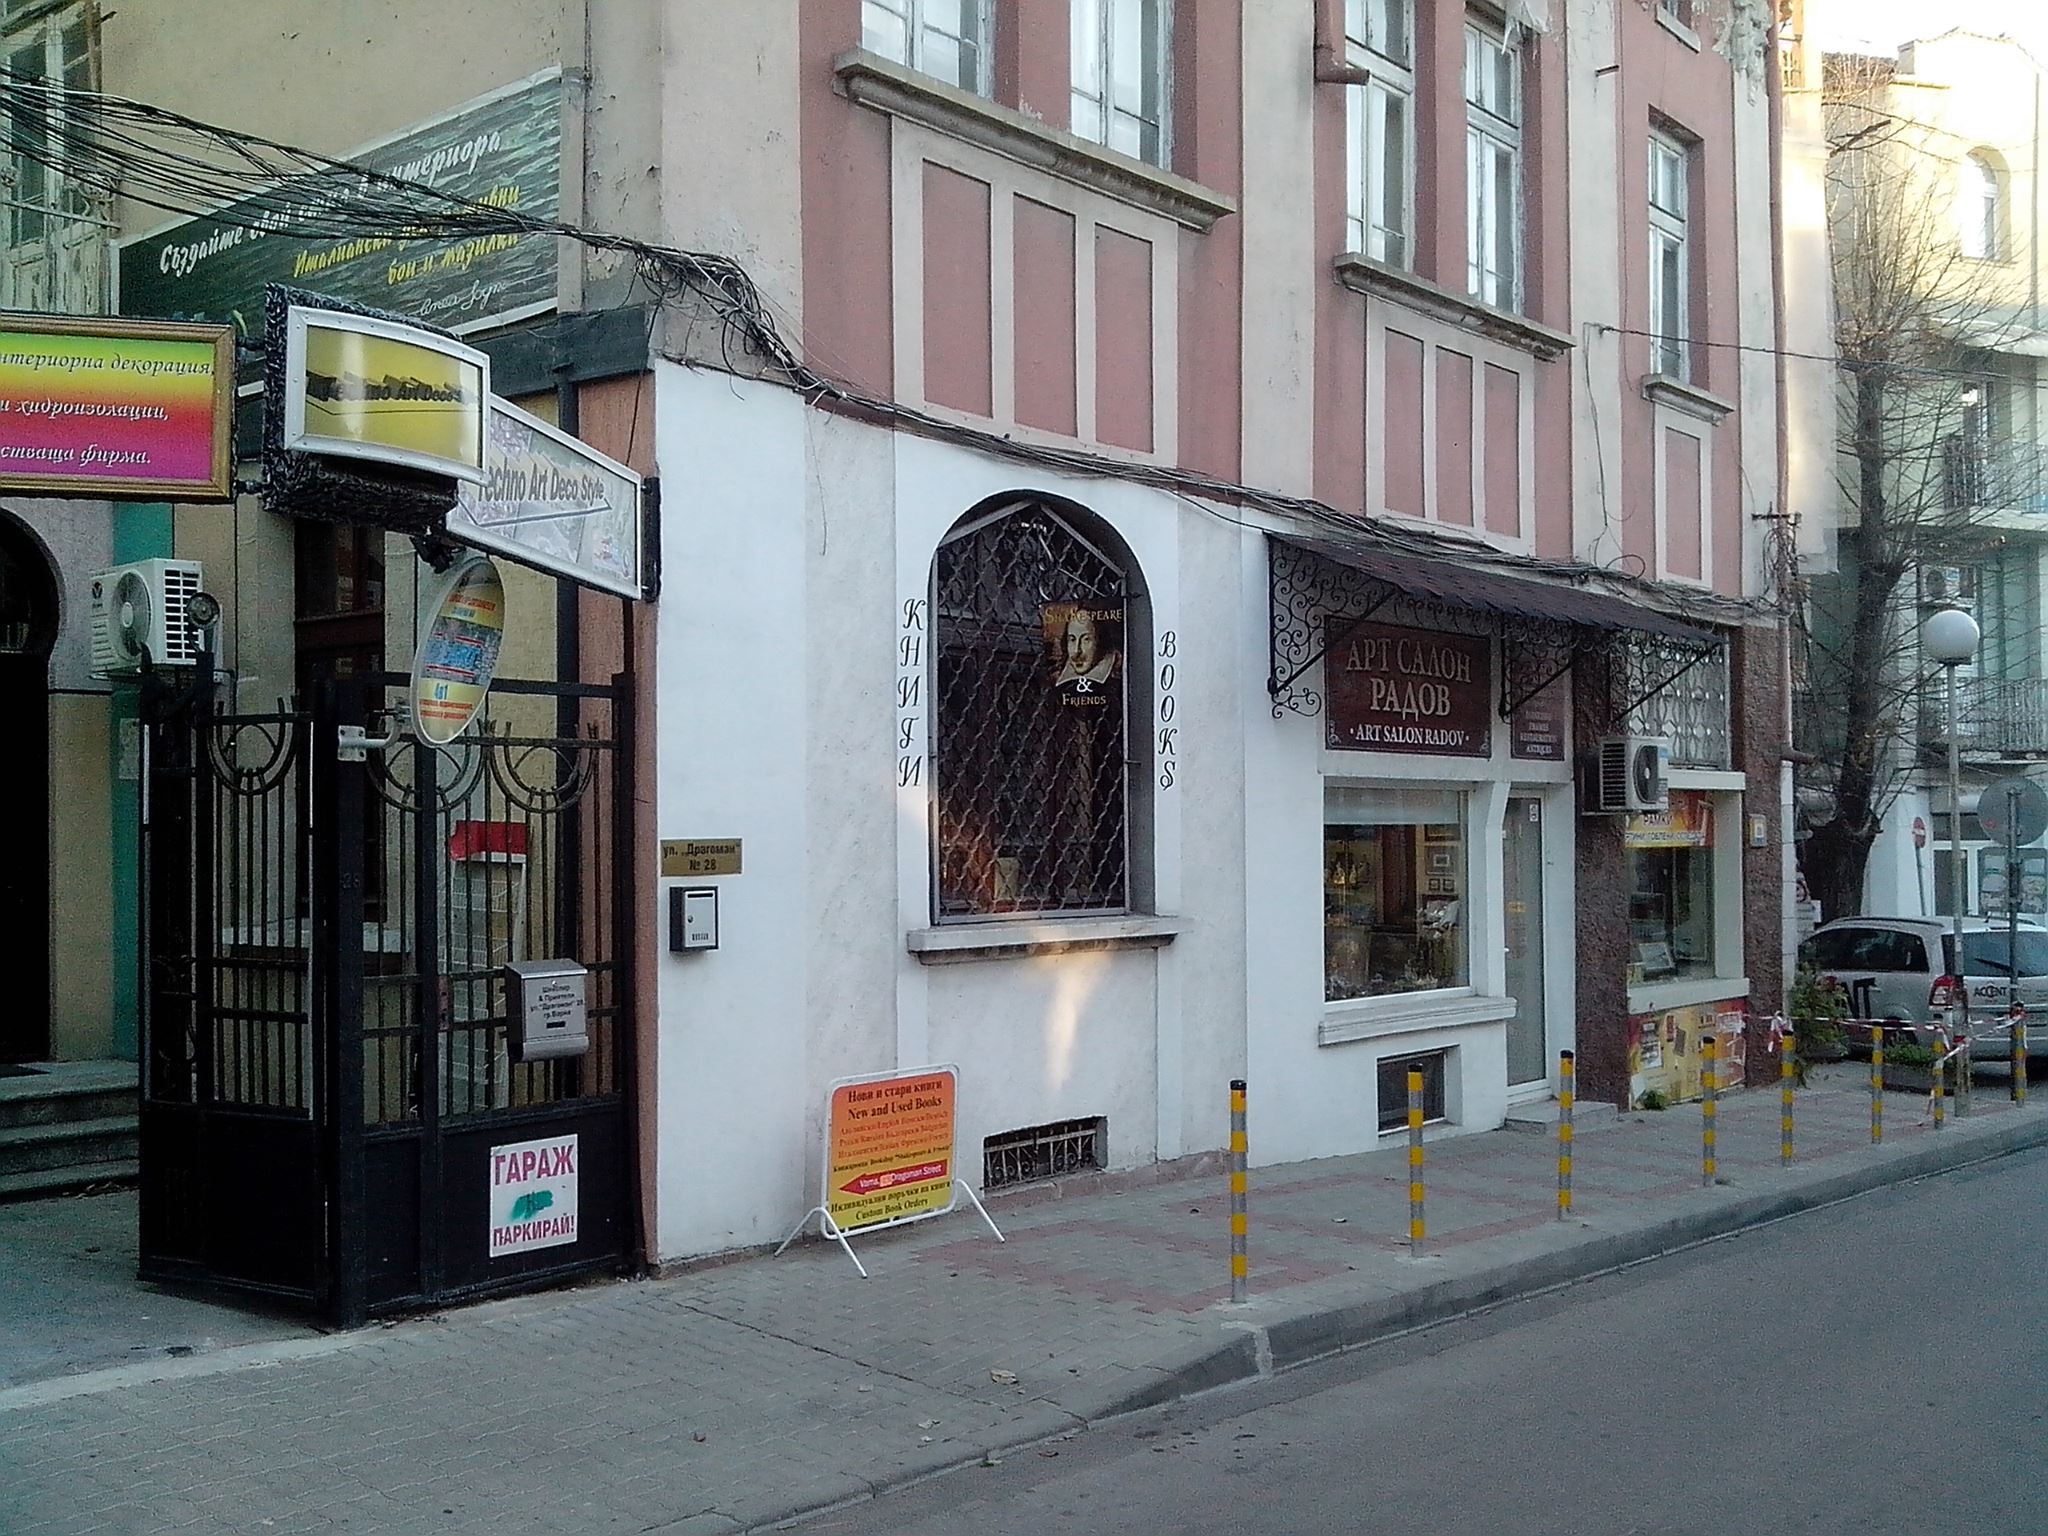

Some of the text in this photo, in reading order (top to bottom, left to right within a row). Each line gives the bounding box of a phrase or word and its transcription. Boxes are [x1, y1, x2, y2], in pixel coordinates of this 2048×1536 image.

[160, 225, 244, 279] Създайте
[111, 352, 214, 376] декорация,
[16, 397, 169, 421] хидроизолации,
[79, 443, 151, 466] фирма.
[528, 463, 549, 502] Art
[551, 467, 579, 501] Deco
[582, 474, 604, 507] Style
[1346, 638, 1472, 683] АРТ САЛОН
[1076, 676, 1093, 692] &
[1062, 693, 1106, 707] FRIENDS
[1370, 677, 1451, 721] РАДОВ
[1356, 723, 1465, 746] ART SALON RADOV
[663, 845, 678, 858] ул.
[704, 859, 717, 870] 28
[1974, 985, 2007, 998] ACCENT
[848, 1090, 874, 1103] Нови
[884, 1086, 912, 1098] стари
[847, 1096, 942, 1120] New and Used Books
[494, 1144, 575, 1186] ГАРАЖ
[885, 1203, 903, 1214] Book
[904, 1198, 929, 1212] Orders
